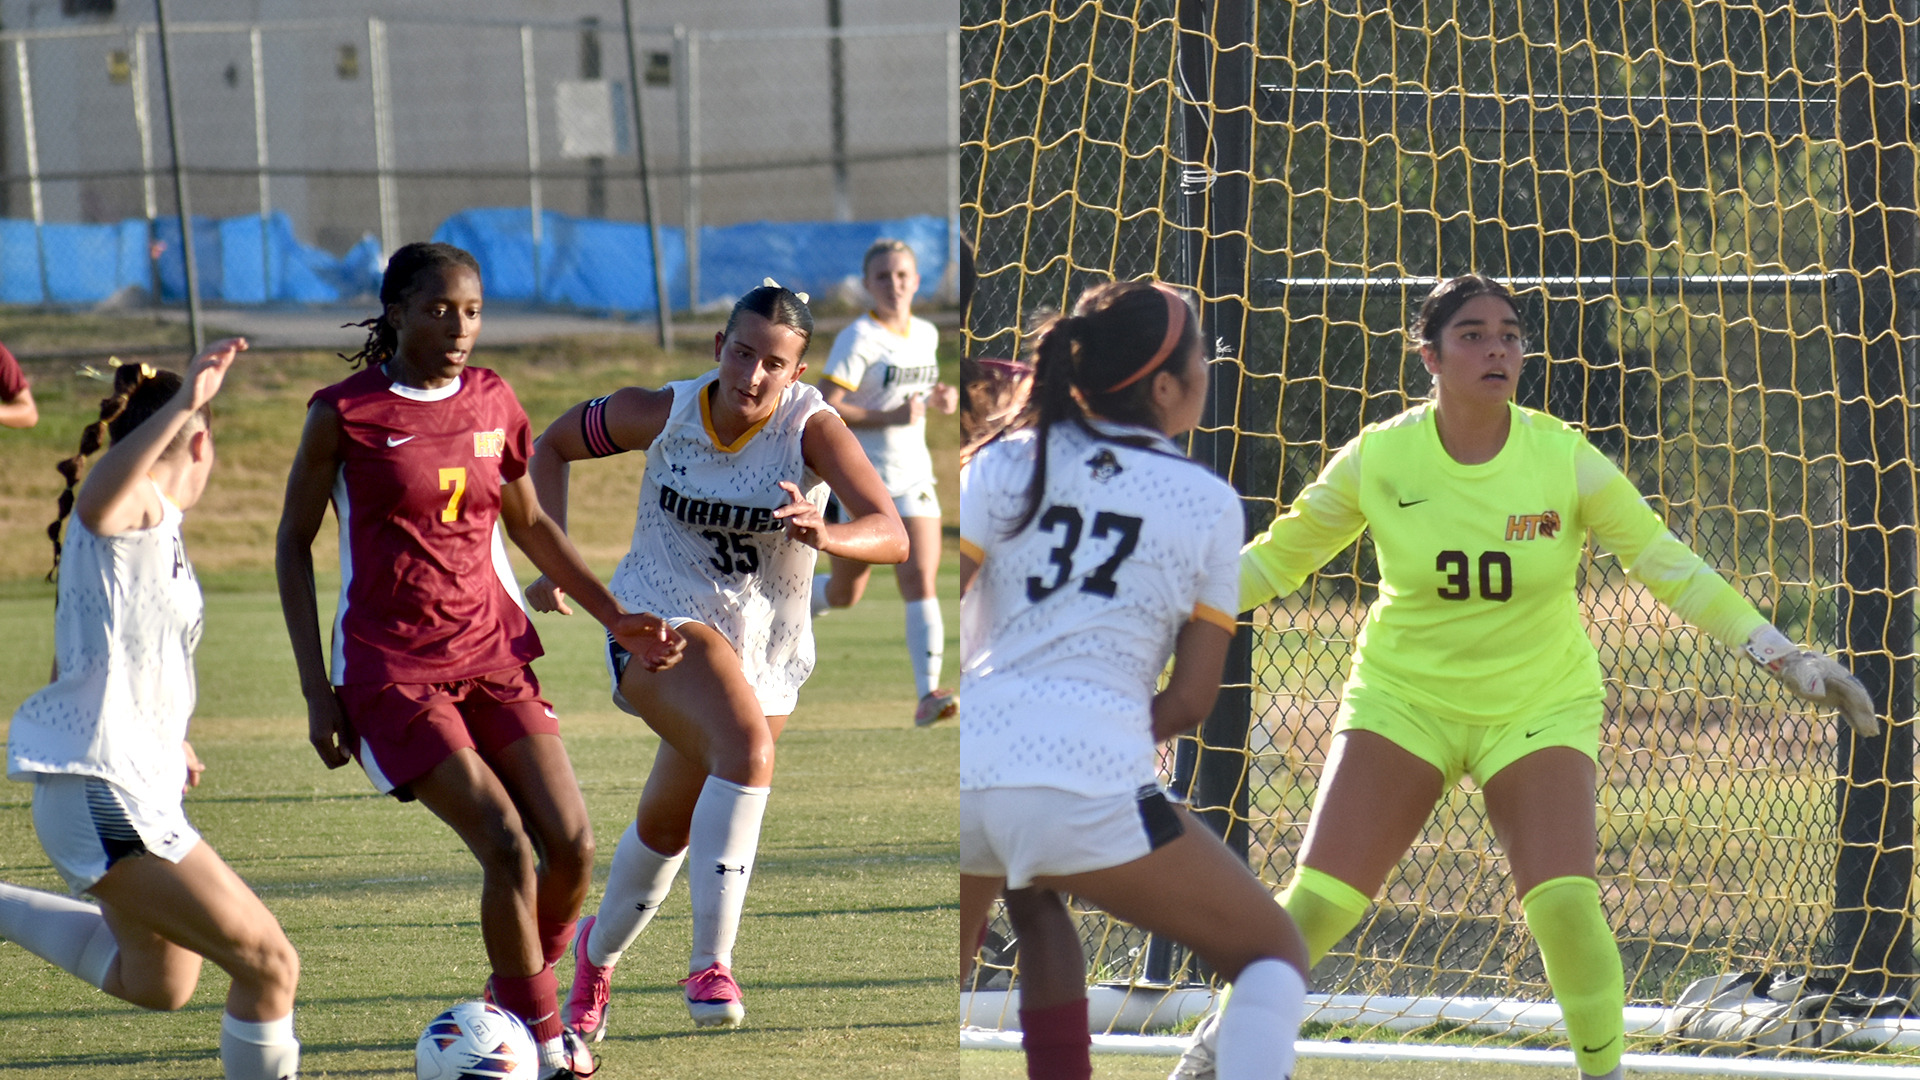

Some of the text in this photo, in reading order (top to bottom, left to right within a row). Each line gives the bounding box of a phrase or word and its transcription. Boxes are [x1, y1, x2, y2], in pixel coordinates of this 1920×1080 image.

[438, 467, 466, 523] 7
[701, 530, 759, 575] 35
[1505, 514, 1543, 541] HT
[1026, 505, 1143, 604] 37
[1436, 550, 1512, 602] 30
